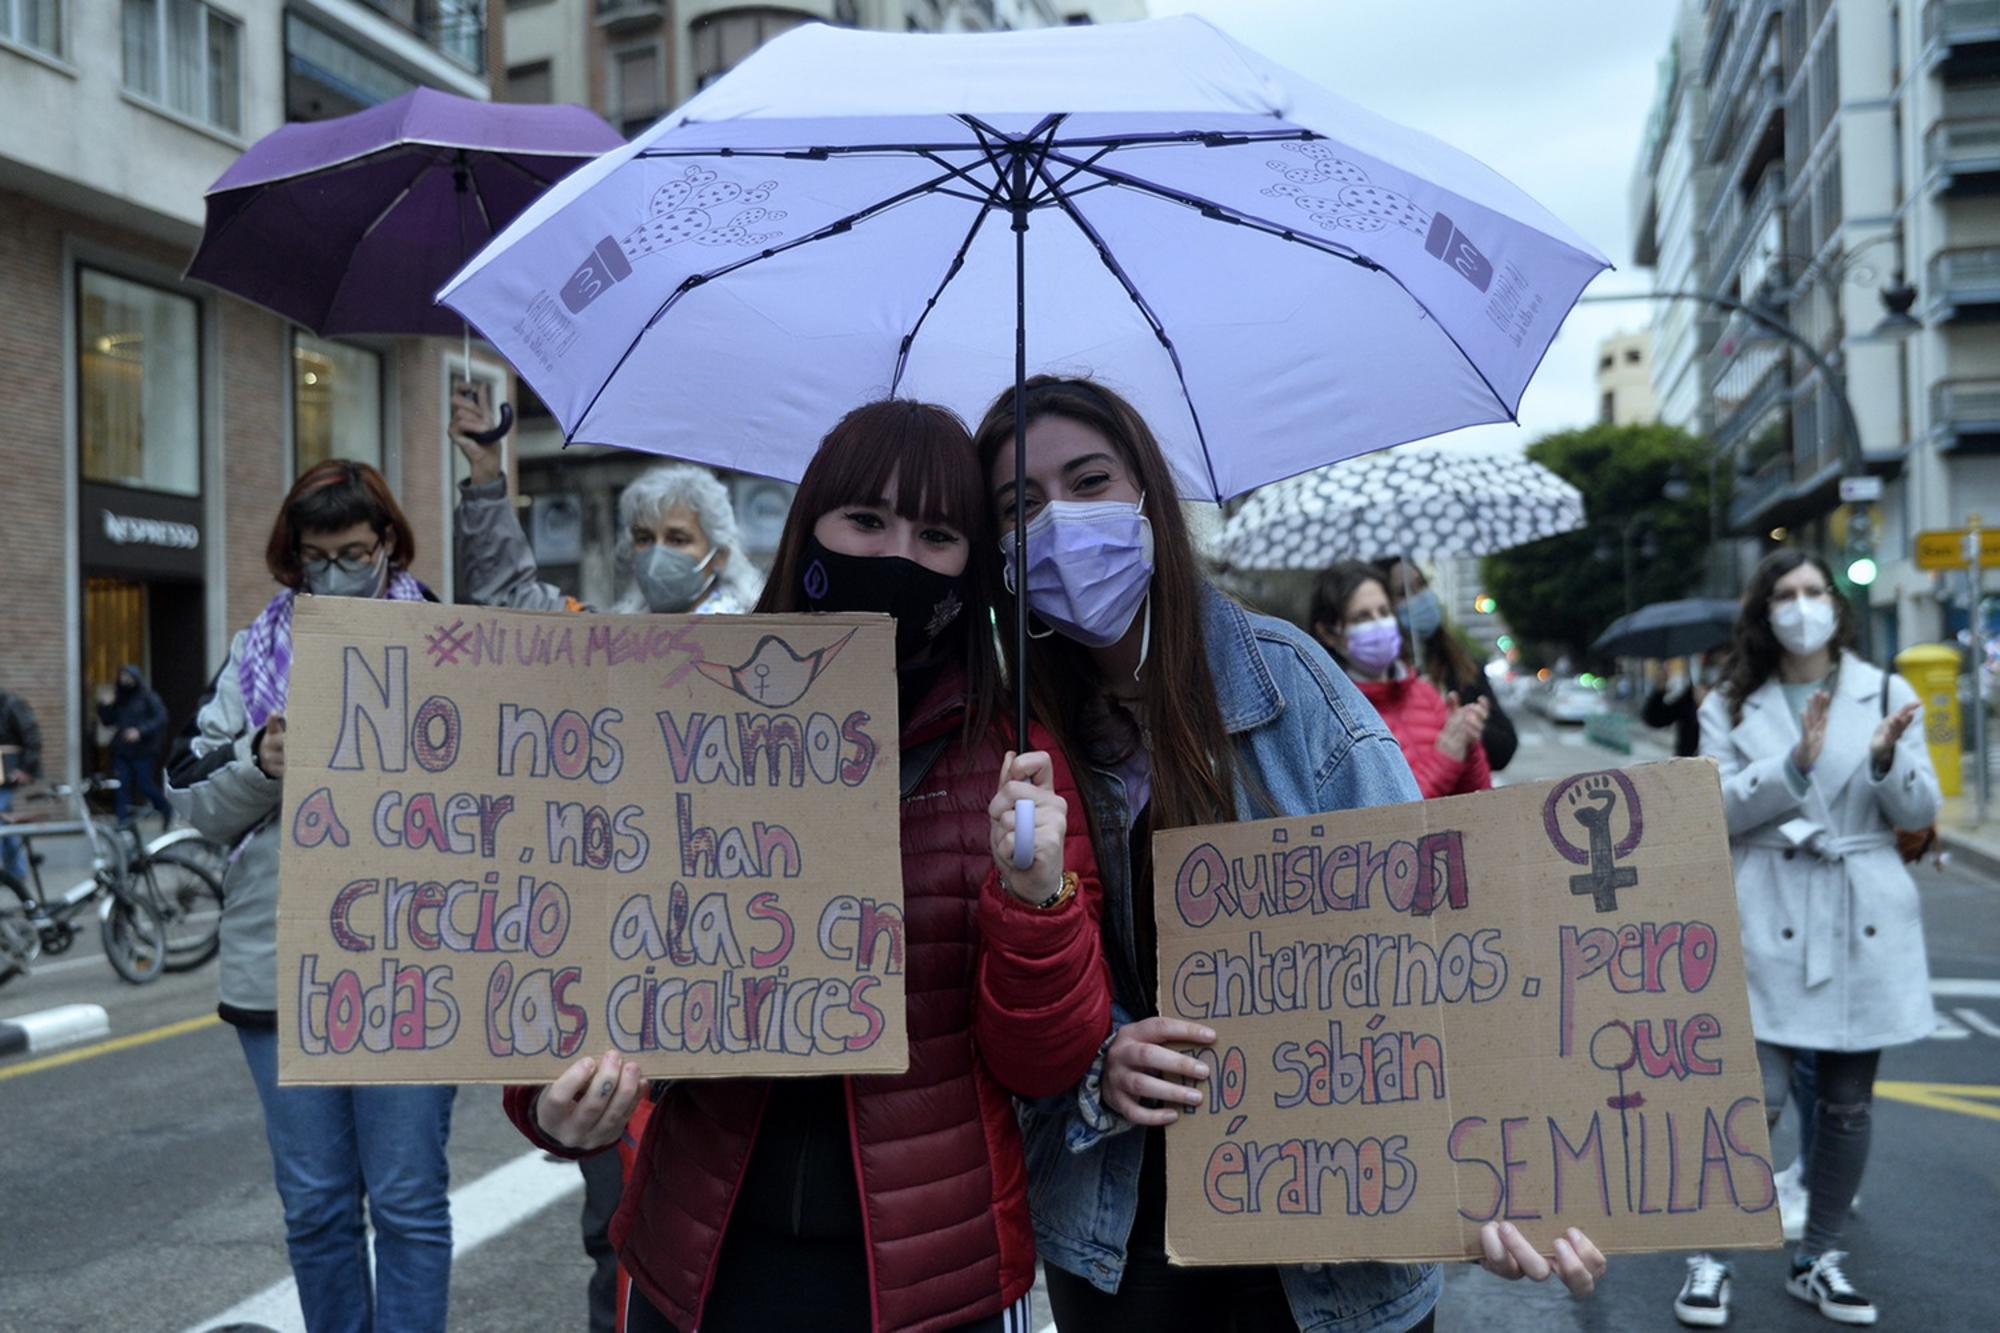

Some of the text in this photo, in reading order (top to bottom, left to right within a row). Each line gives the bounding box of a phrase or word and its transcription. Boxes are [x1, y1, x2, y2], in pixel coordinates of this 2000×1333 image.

[328, 645, 876, 787] No nos vamos
[293, 787, 349, 847] a
[546, 801, 649, 873] nos
[676, 792, 801, 878] han
[1175, 825, 1468, 928] Quisieron
[330, 871, 571, 958] crecido
[817, 894, 905, 975] en
[299, 954, 886, 1058] todas las cicatrices
[1559, 920, 1717, 1057] pero
[1272, 1014, 1445, 1108] sabían
[1203, 1096, 1777, 1222] éramos SEMILLAS
